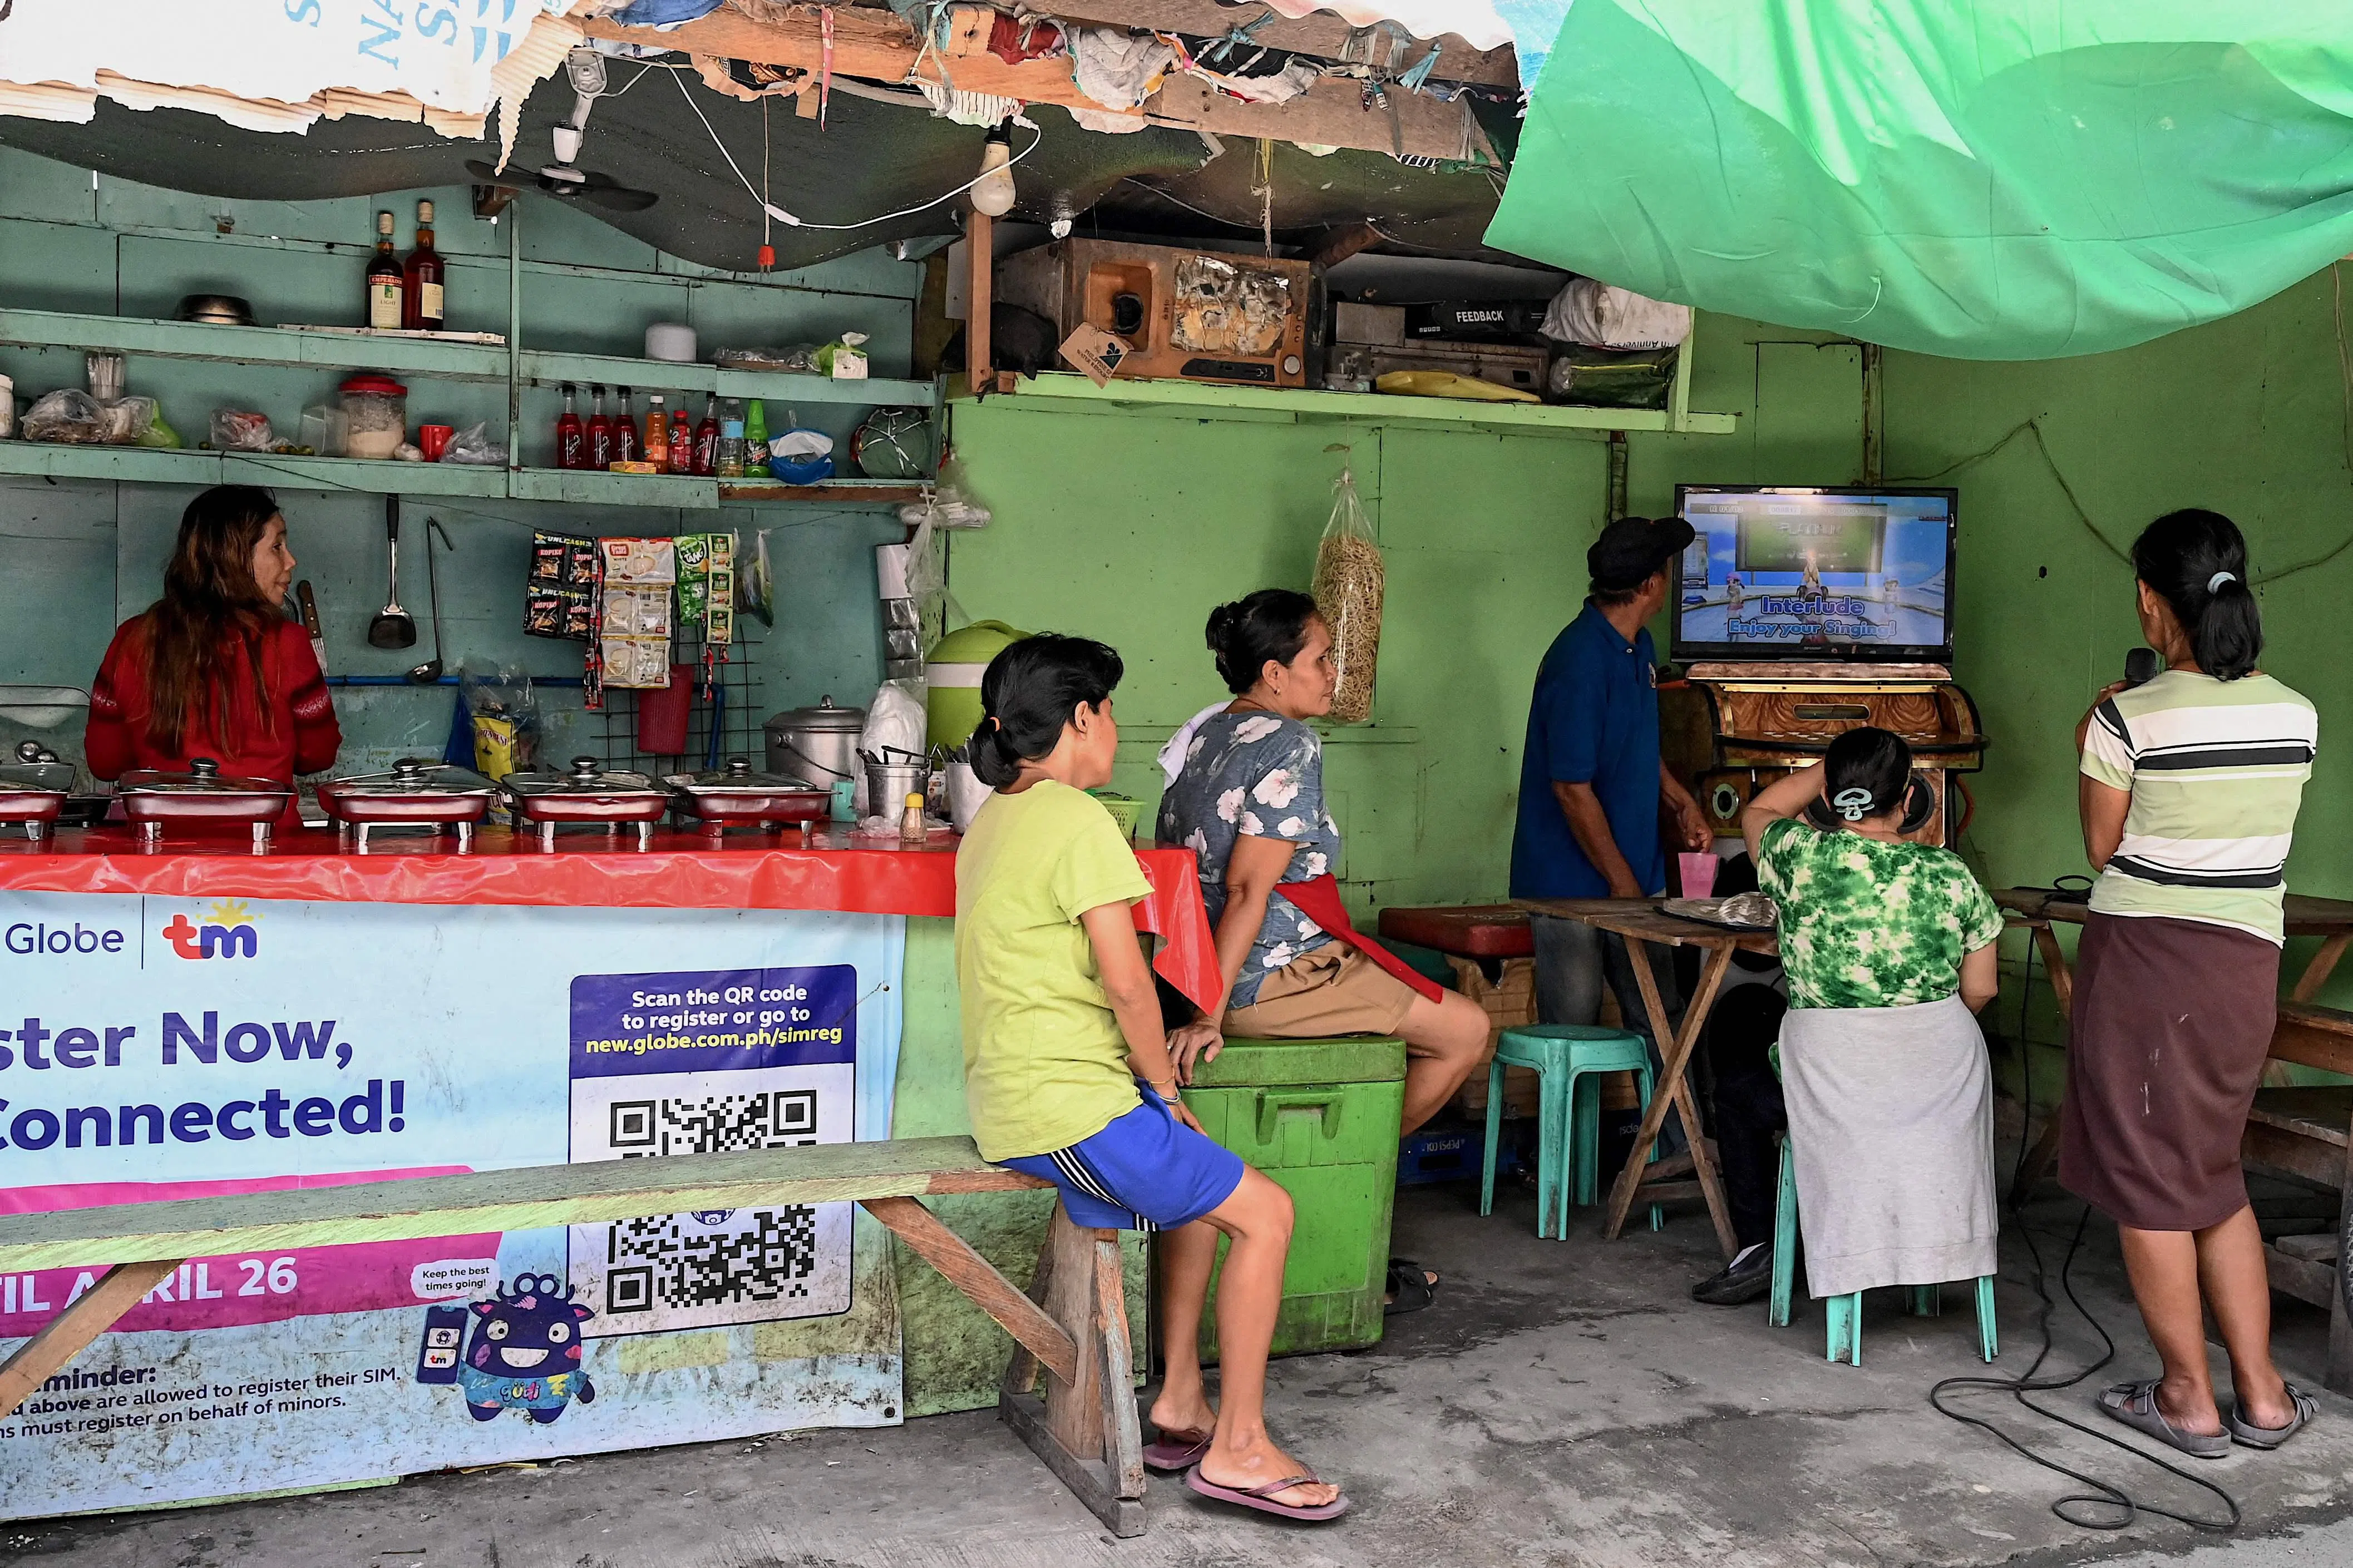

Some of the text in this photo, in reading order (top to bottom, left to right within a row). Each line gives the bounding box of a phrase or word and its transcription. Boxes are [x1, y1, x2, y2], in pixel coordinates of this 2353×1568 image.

[1456, 310, 1504, 323] FEEDBACK
[684, 548, 703, 563] TANG
[1762, 595, 1864, 614] Interlude
[1728, 619, 1896, 638] Enjoy your Singing!
[6, 914, 258, 959] Globe tm
[632, 984, 808, 1008] Scan the QR code
[621, 1006, 810, 1033] to register or go to
[161, 1010, 353, 1069] Now,
[586, 1026, 843, 1055] new.globe.com.ph/simreg
[0, 1079, 405, 1151] onnected!
[1619, 1123, 1639, 1137] epsi
[423, 1270, 447, 1279] Keep
[468, 1266, 490, 1275] best
[456, 1279, 486, 1290] going!
[0, 1257, 298, 1314] IL ARIL 26
[430, 1354, 447, 1364] tm
[29, 1399, 91, 1414] above
[96, 1395, 127, 1409] are
[134, 1384, 208, 1406] allowed
[213, 1384, 233, 1397] to
[239, 1378, 310, 1398] register
[315, 1372, 358, 1388] their
[363, 1367, 401, 1383] SIM.
[34, 1365, 156, 1392] minder:
[500, 1382, 541, 1402] güdi
[22, 1419, 72, 1437] must
[79, 1414, 154, 1433] register
[159, 1411, 182, 1424] on
[189, 1401, 248, 1421] behalf
[254, 1398, 273, 1414] of
[278, 1396, 346, 1413] minors.
